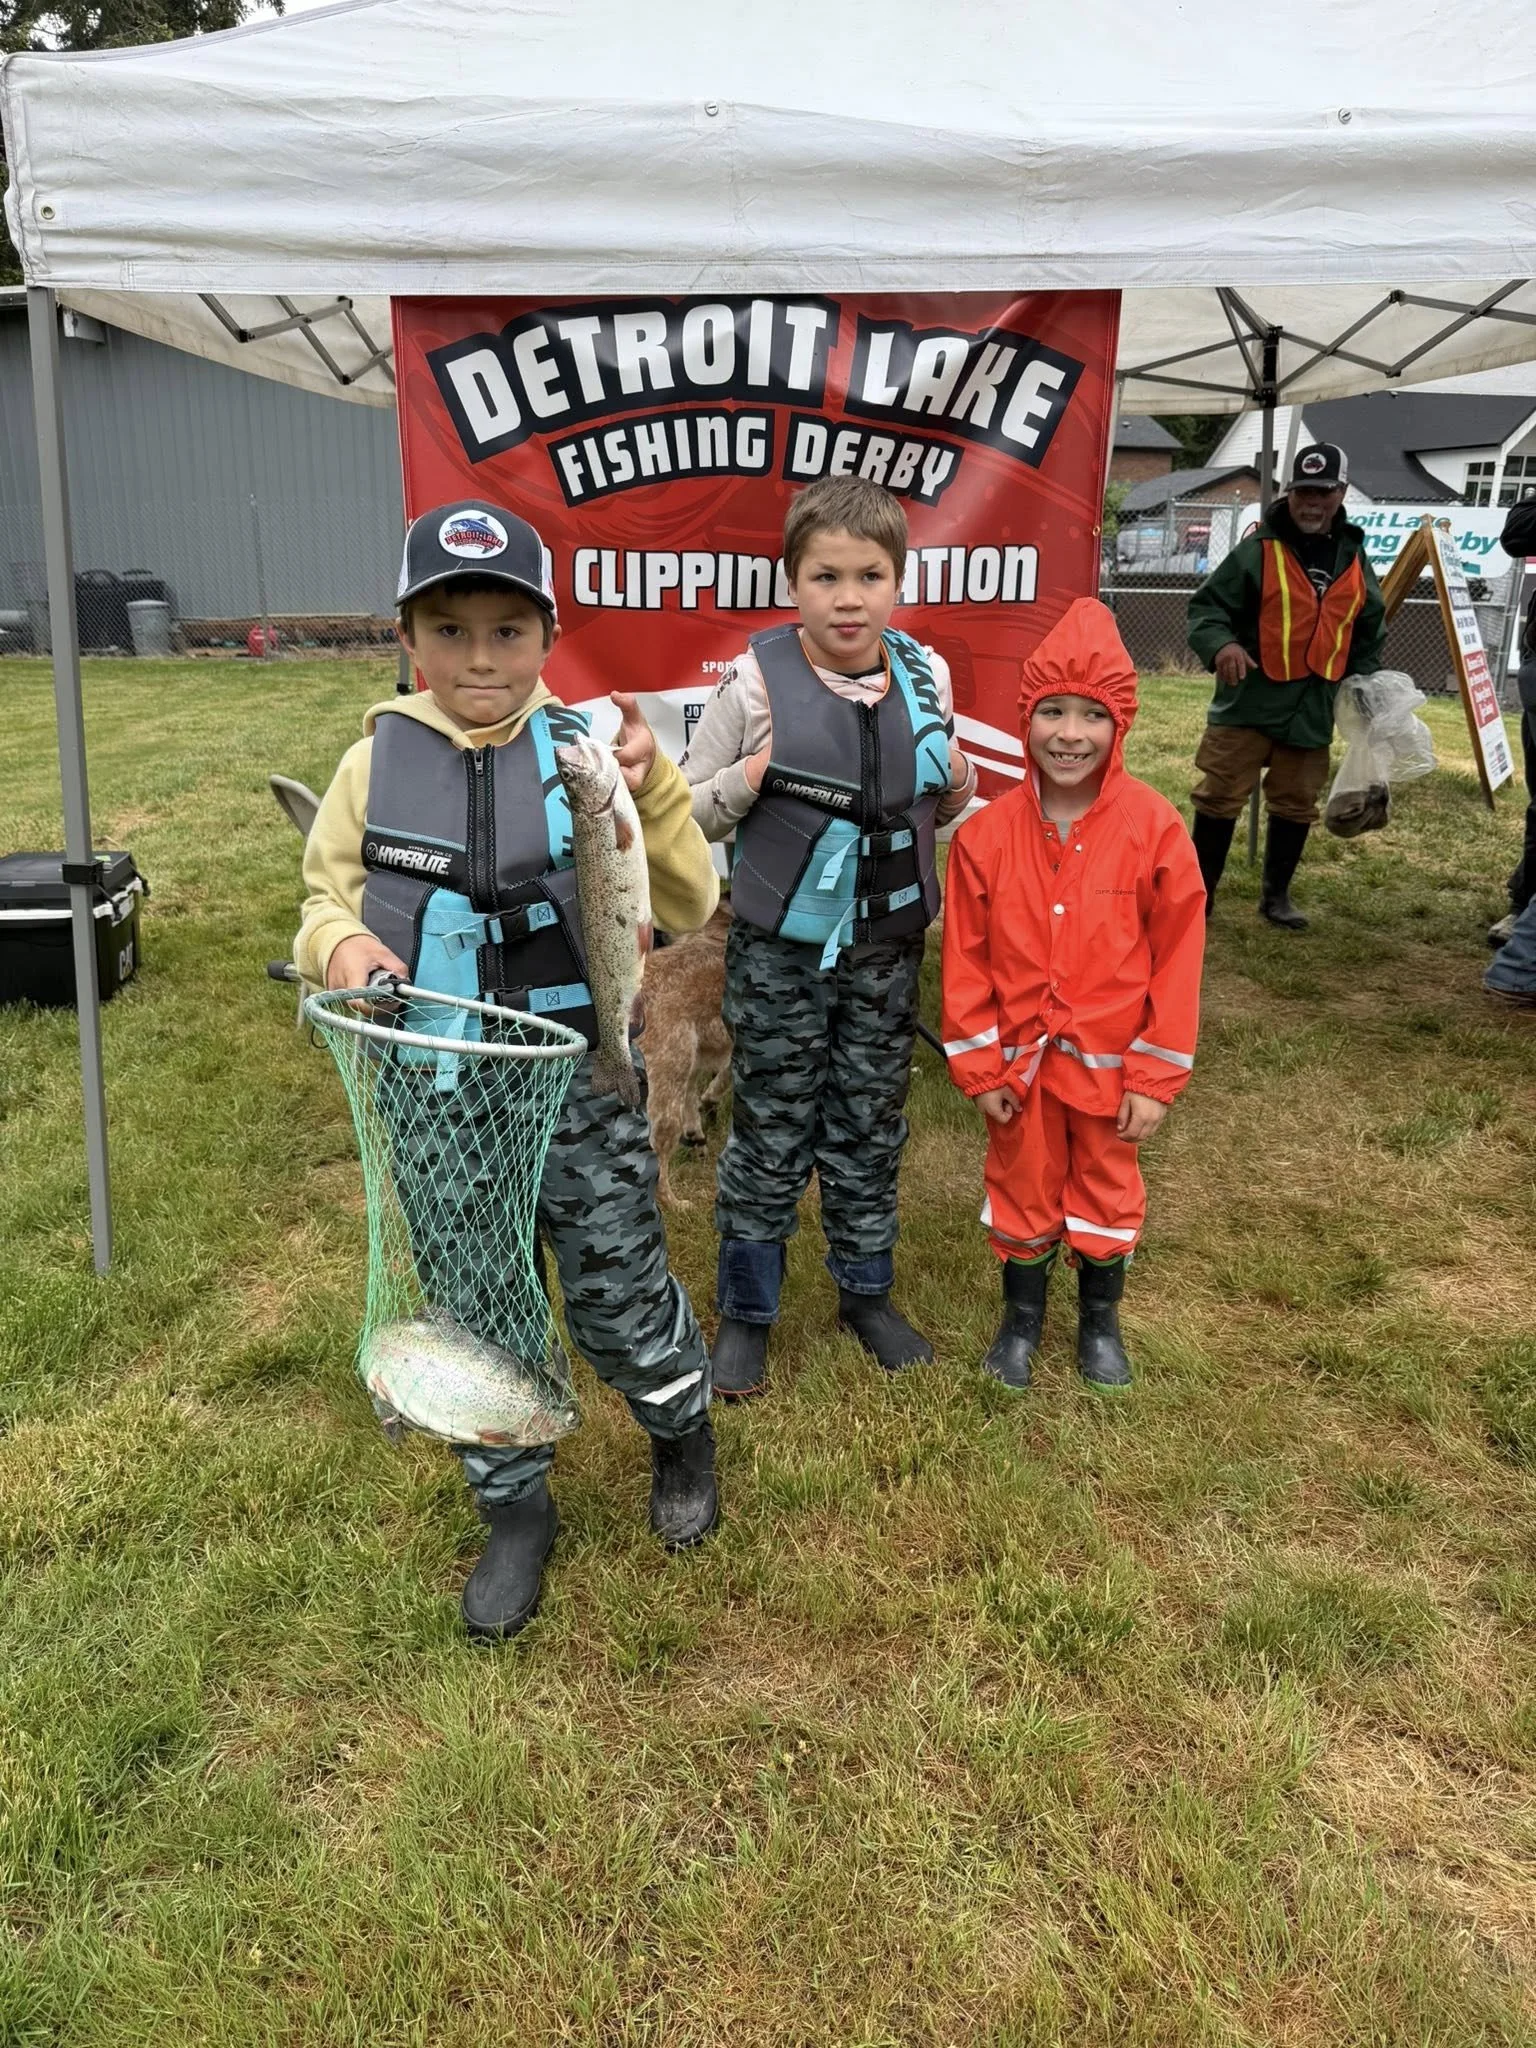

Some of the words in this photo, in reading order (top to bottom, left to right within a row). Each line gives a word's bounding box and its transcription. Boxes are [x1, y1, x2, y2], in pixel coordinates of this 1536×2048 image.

[446, 300, 827, 444] DETROIT
[862, 331, 1066, 449] LAKE
[557, 415, 767, 497] FISHING
[792, 422, 955, 497] DERBY
[1389, 513, 1451, 528] Lae
[897, 545, 1038, 604] ATION
[785, 782, 853, 808] HYPERLITE
[378, 845, 452, 874] HYPERLITE
